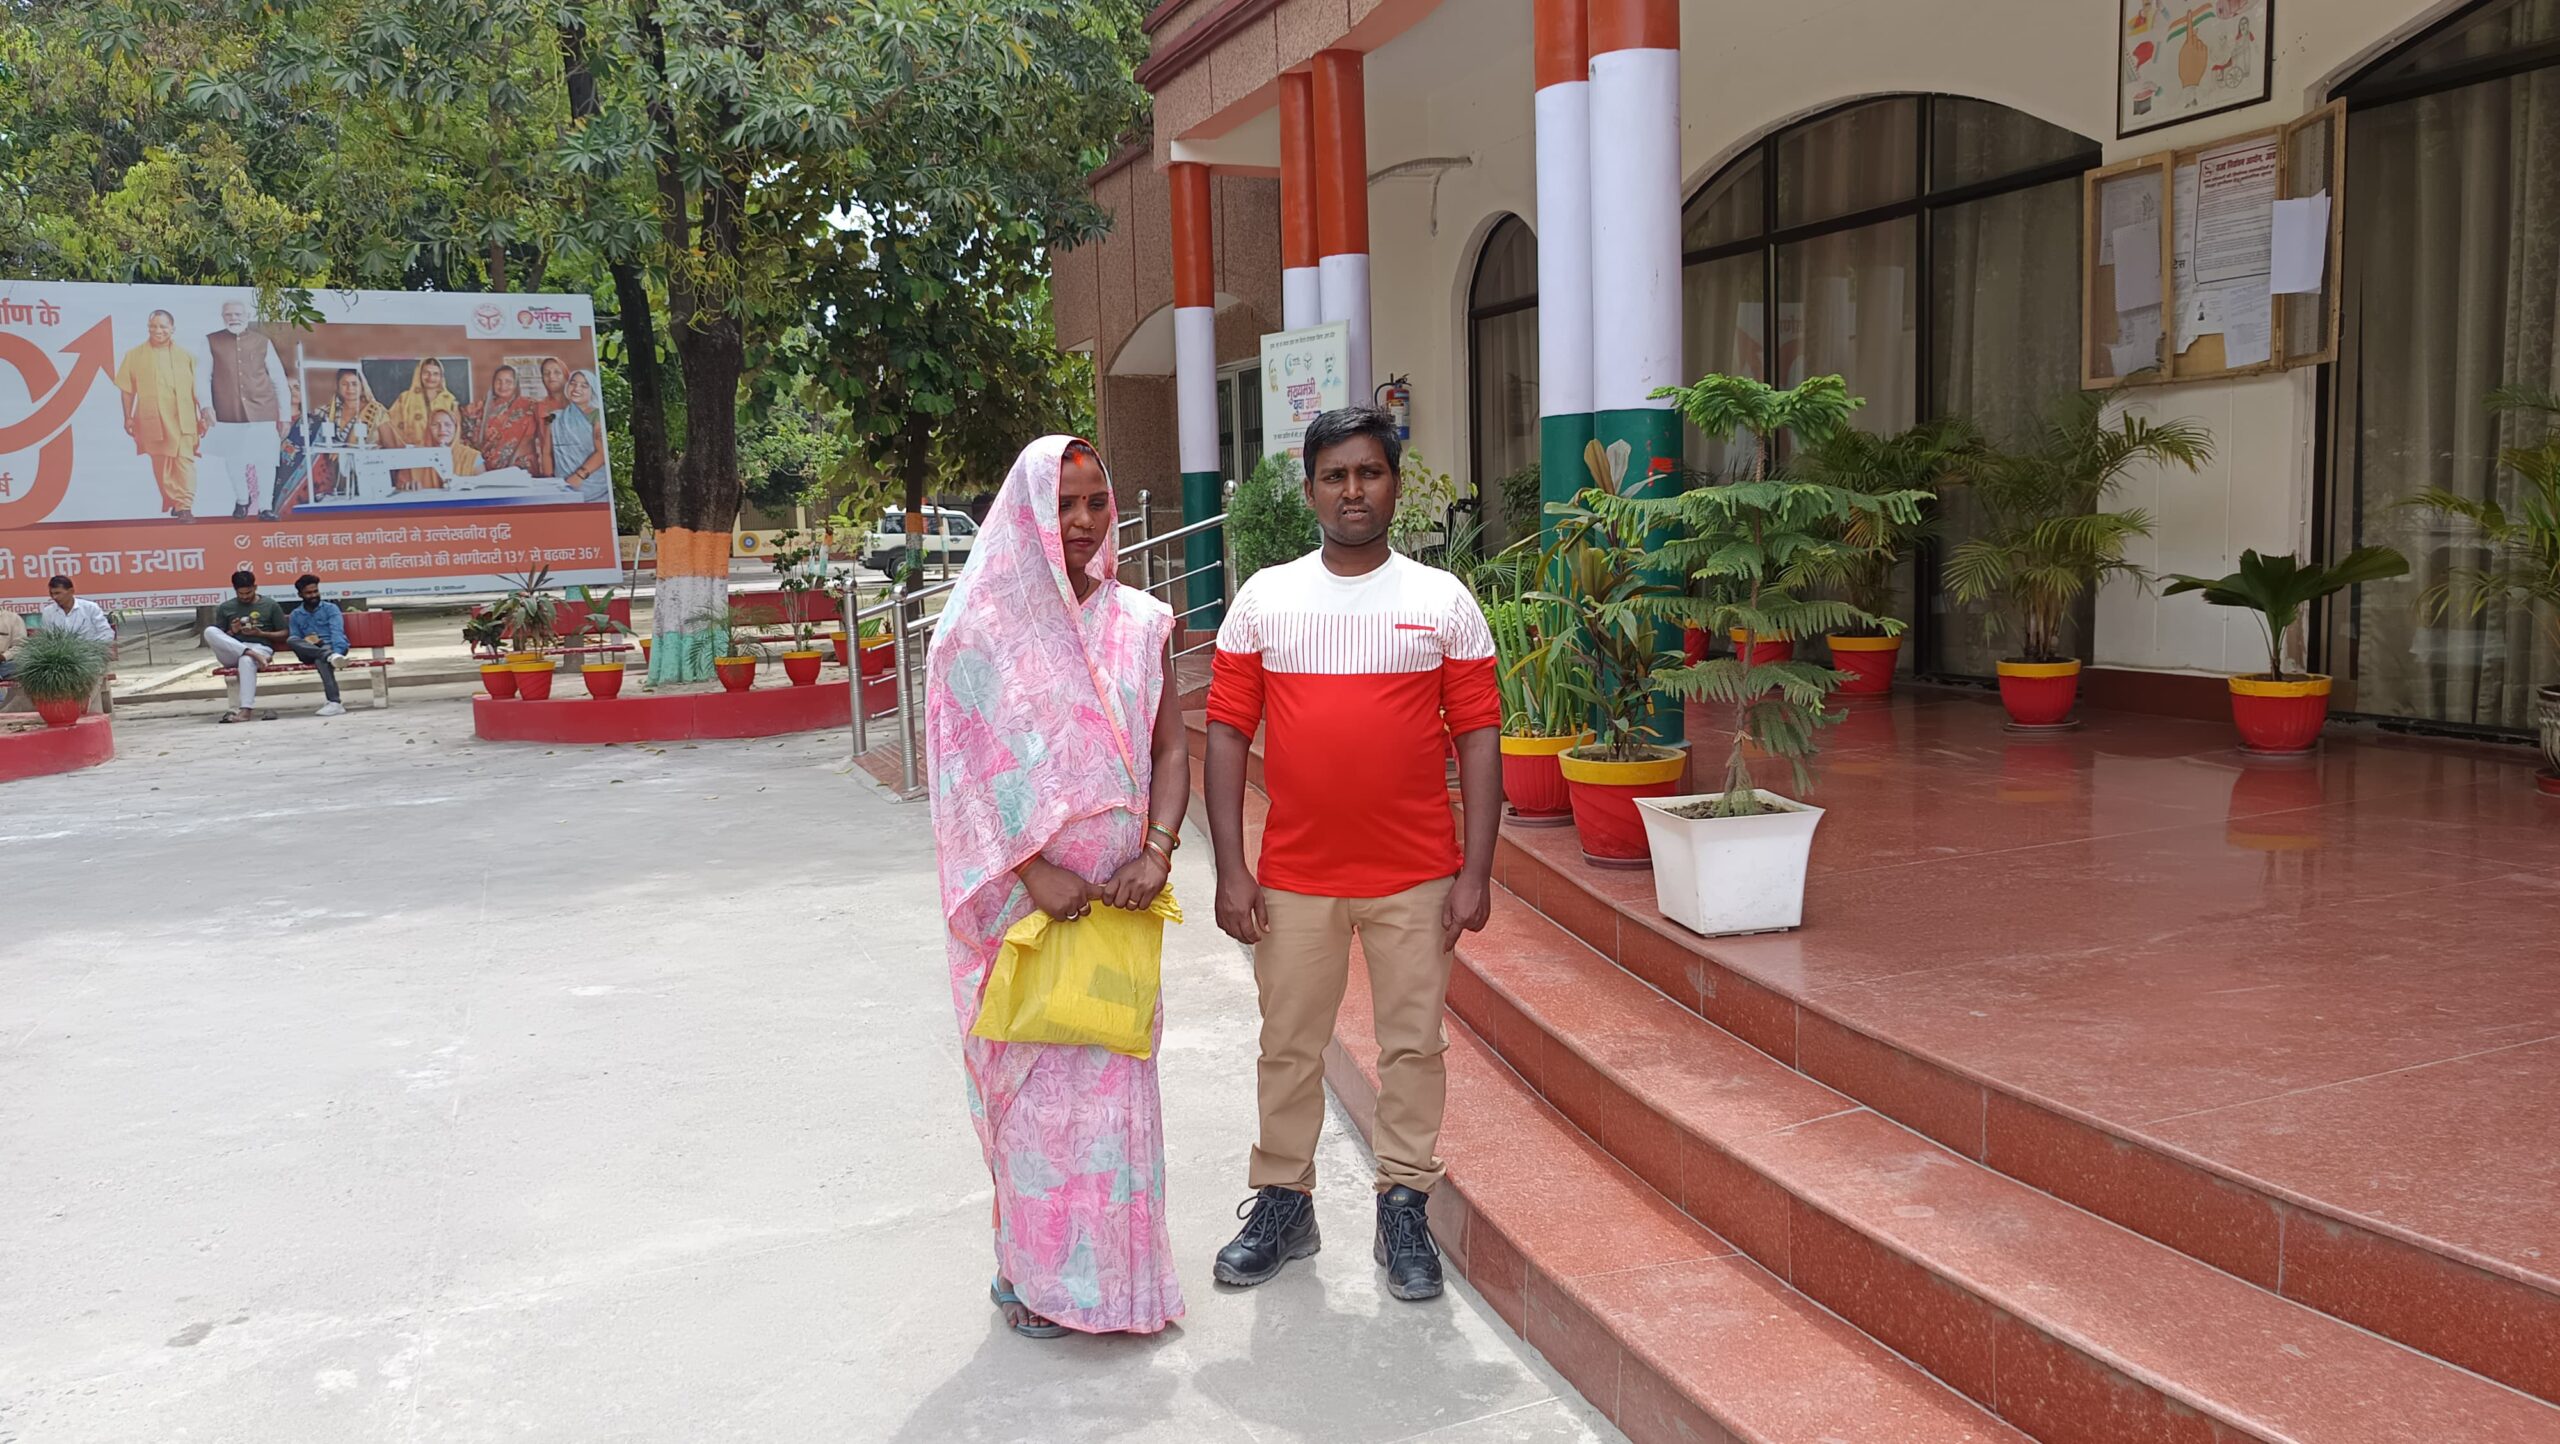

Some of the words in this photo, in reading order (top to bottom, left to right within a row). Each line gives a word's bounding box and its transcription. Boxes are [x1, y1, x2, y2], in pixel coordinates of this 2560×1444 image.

[35, 298, 61, 327] के
[261, 531, 304, 548] महिला
[306, 534, 329, 546] श्रम
[331, 532, 352, 545] बल
[355, 527, 407, 544] भागीदारी
[423, 524, 487, 542] उल्लेखनीय
[488, 522, 512, 543] वृद्धि
[22, 546, 82, 579] शक्ति
[86, 551, 121, 576] का
[125, 548, 206, 574] उत्थान
[264, 561, 273, 575] 9
[316, 559, 338, 572] श्रम
[340, 557, 361, 571] बल
[434, 550, 449, 566] की
[452, 548, 502, 565] भागीदारी
[529, 546, 541, 562] से
[150, 593, 179, 609] इंजन
[180, 592, 220, 606] सरकार
